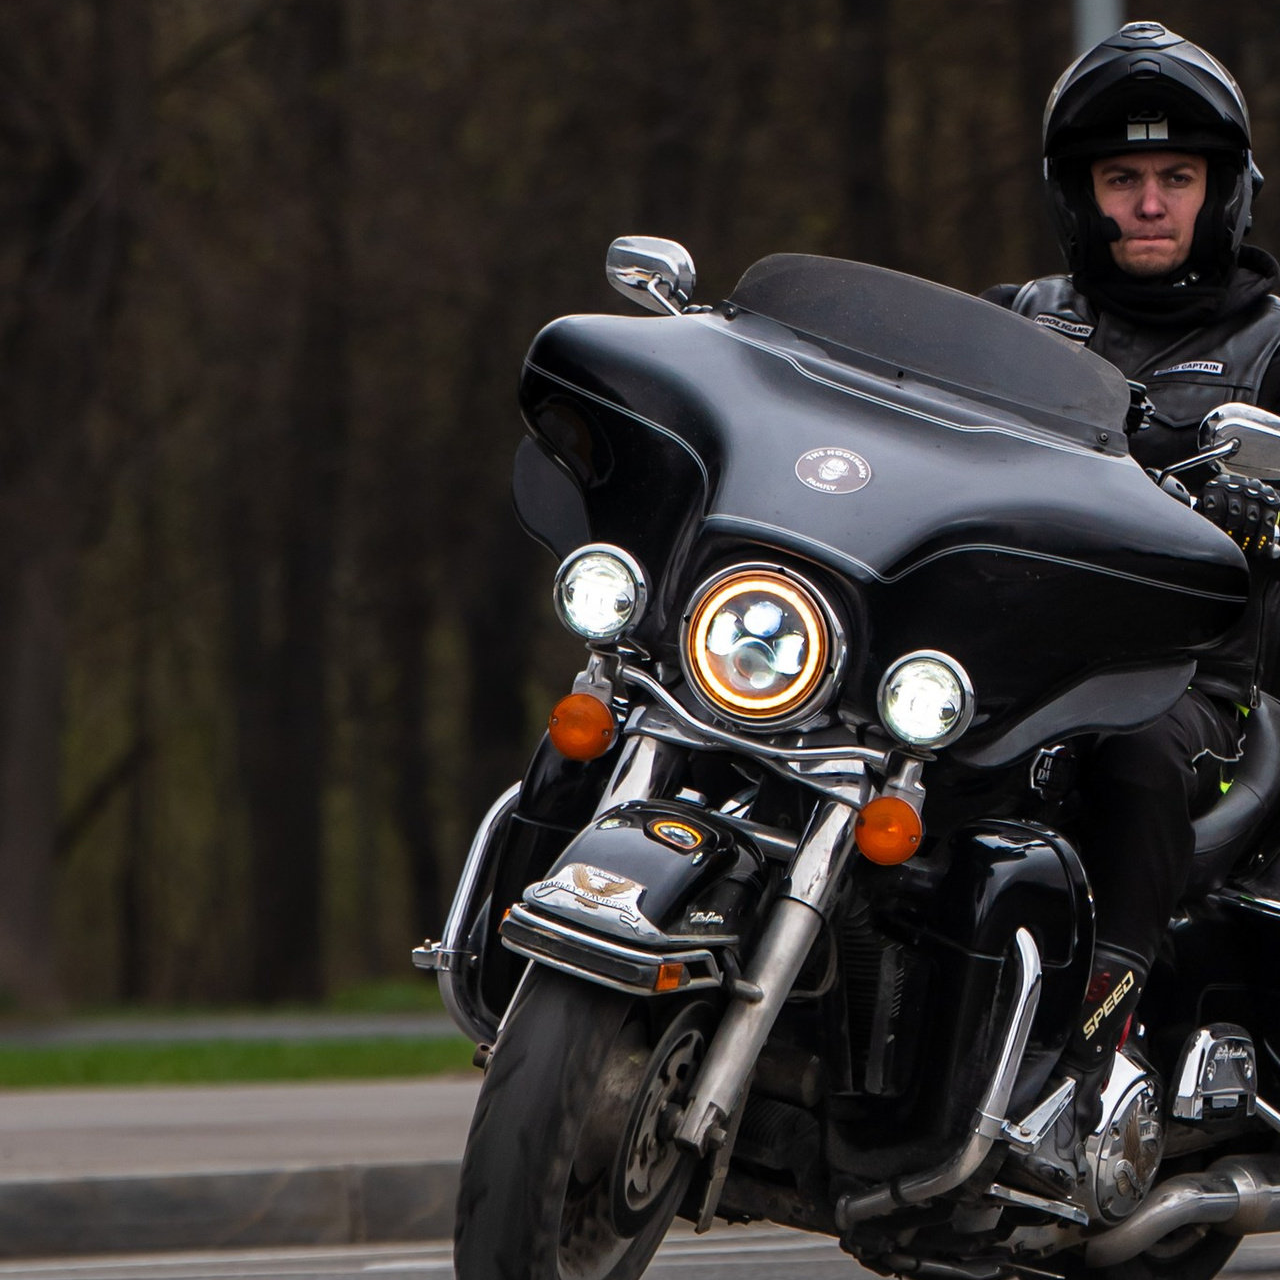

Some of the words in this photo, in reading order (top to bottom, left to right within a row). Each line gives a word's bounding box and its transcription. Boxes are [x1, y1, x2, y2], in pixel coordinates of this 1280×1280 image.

[1036, 316, 1091, 334] HOOLIGANS
[1181, 362, 1220, 372] CAPTAIN
[805, 450, 826, 462] THE
[826, 449, 867, 480] HOOLIGANS
[805, 477, 837, 491] FAMILY
[1082, 970, 1135, 1041] SPEED
